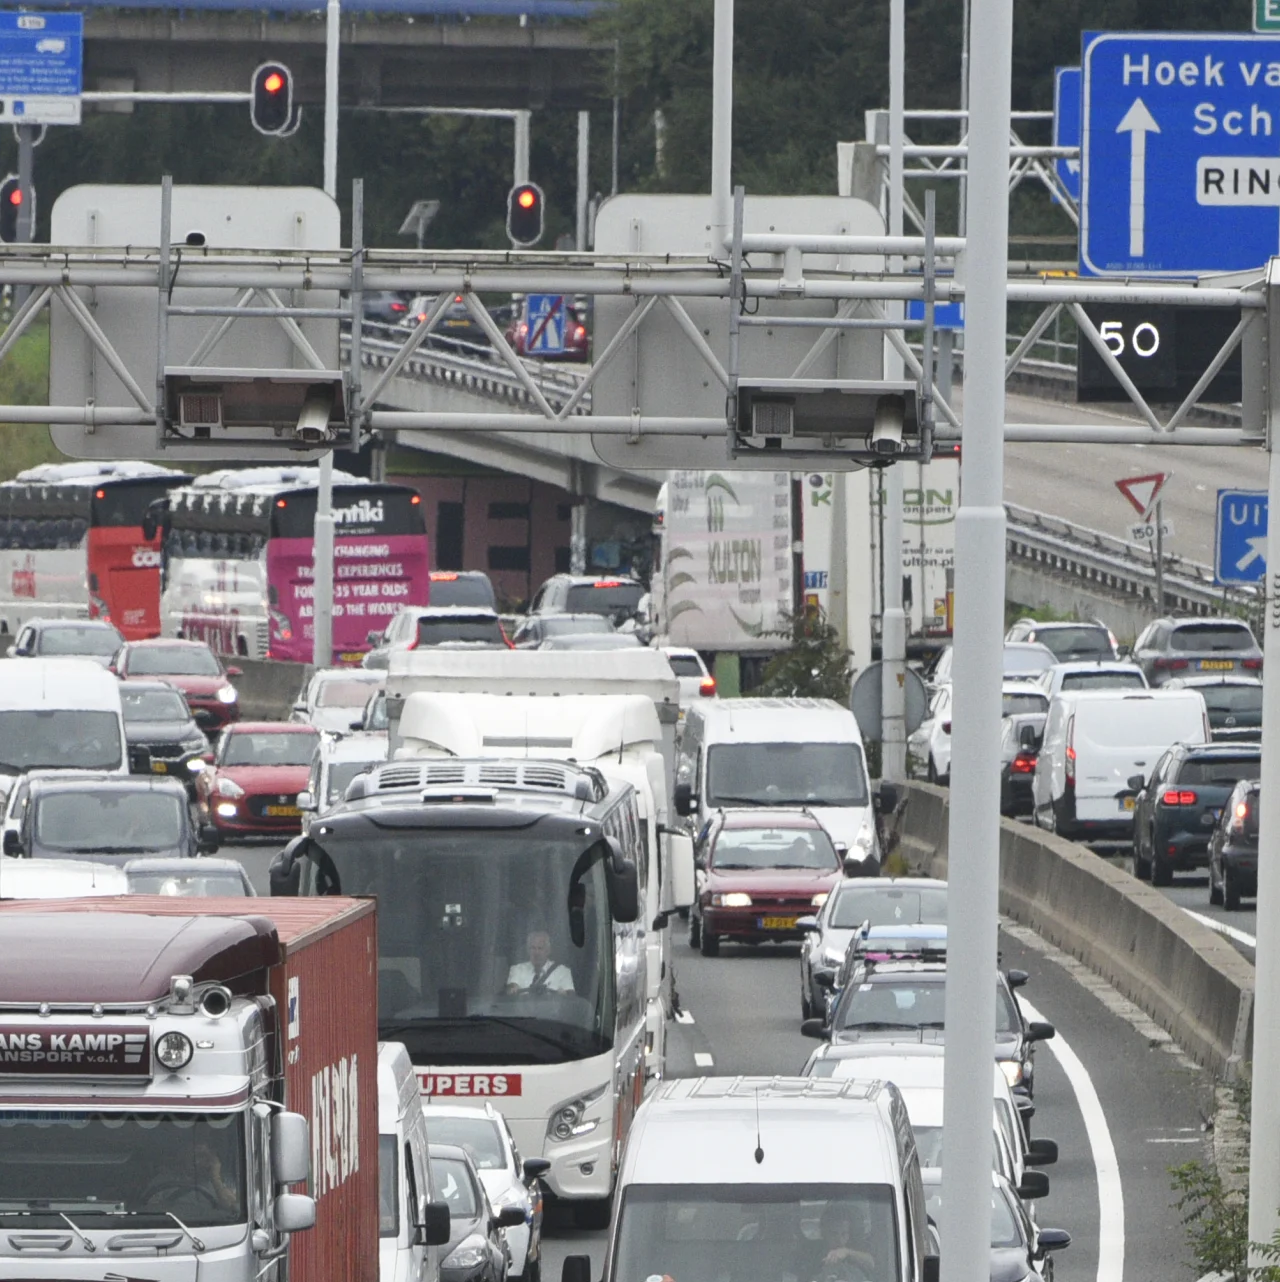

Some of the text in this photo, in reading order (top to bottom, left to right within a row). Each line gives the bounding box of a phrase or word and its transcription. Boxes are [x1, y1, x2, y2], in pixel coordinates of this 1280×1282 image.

[1123, 54, 1224, 87] Hoek
[1100, 321, 1160, 357] 50
[331, 499, 384, 523] ontiki
[1230, 502, 1269, 526] UI
[1131, 527, 1154, 541] 150
[347, 603, 364, 616] THE
[50, 1033, 123, 1051] KAMP
[418, 1075, 508, 1095] UPERS
